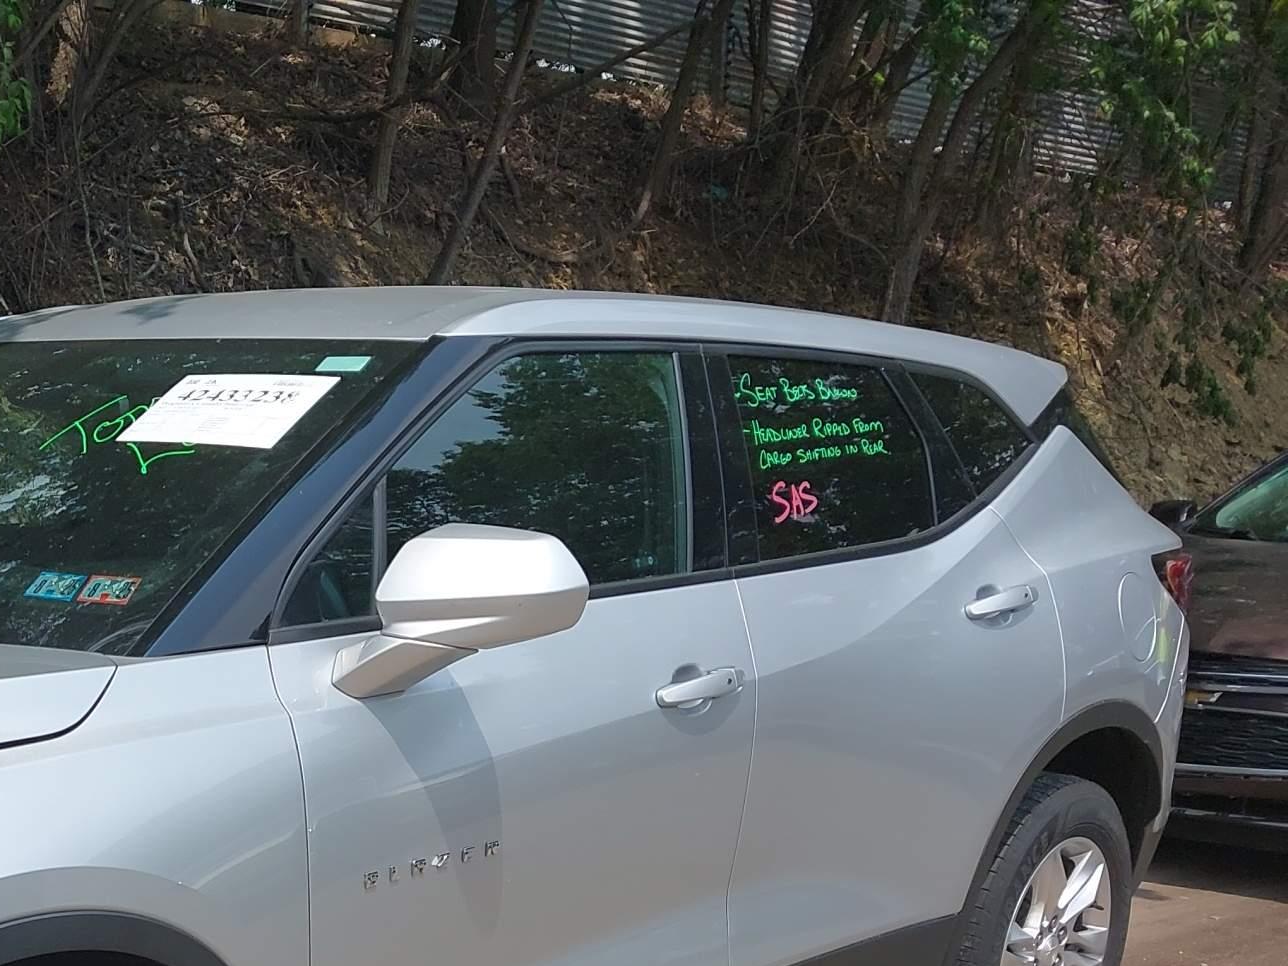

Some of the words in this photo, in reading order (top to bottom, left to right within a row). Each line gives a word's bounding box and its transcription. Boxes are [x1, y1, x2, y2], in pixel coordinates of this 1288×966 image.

[177, 388, 301, 404] 42433238
[740, 373, 777, 407] SEAT
[759, 449, 792, 469] CARGO
[796, 446, 841, 463] SHIFTING
[845, 444, 858, 455] IN
[773, 481, 818, 523] SAS
